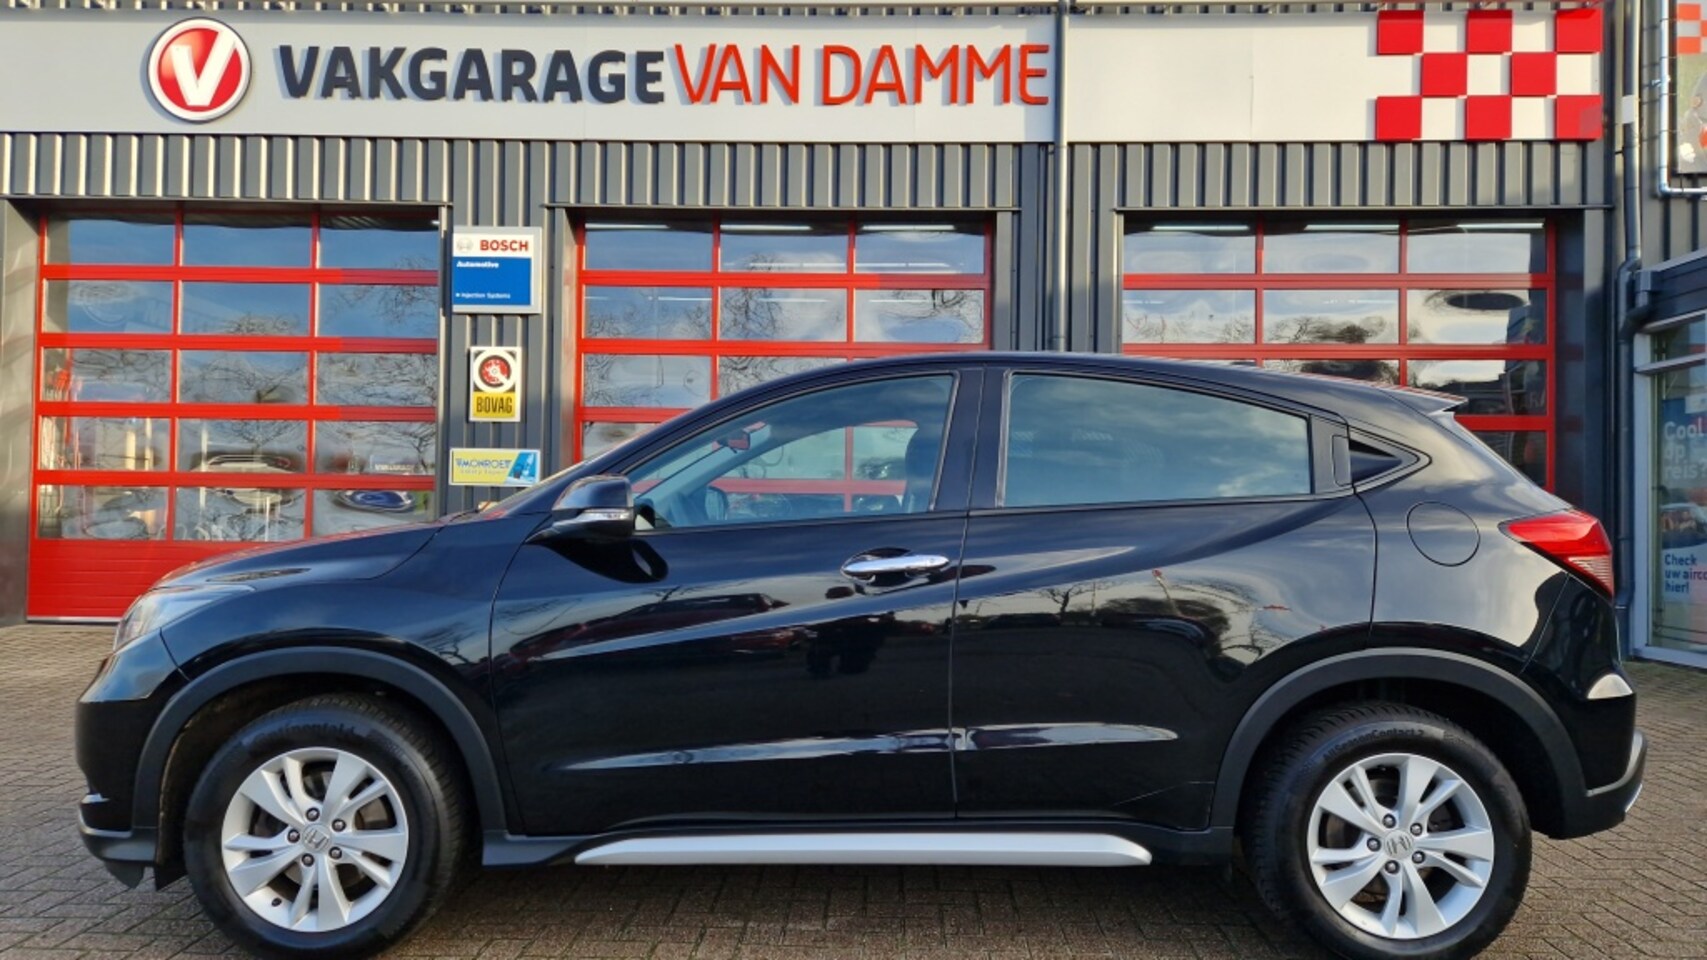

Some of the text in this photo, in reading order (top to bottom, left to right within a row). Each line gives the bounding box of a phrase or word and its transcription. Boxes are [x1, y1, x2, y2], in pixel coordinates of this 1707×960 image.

[170, 30, 236, 106] V
[278, 43, 1050, 106] VAKGARAGE VAN DAMME
[479, 239, 529, 252] BOSCH
[456, 259, 500, 270] Automotive
[486, 292, 512, 300] Systems
[476, 395, 513, 414] BOVAG
[1664, 417, 1704, 441] Cool
[462, 459, 505, 469] MONROE
[1664, 553, 1697, 566] Check
[1665, 569, 1681, 579] uw
[1665, 580, 1690, 594] hier!
